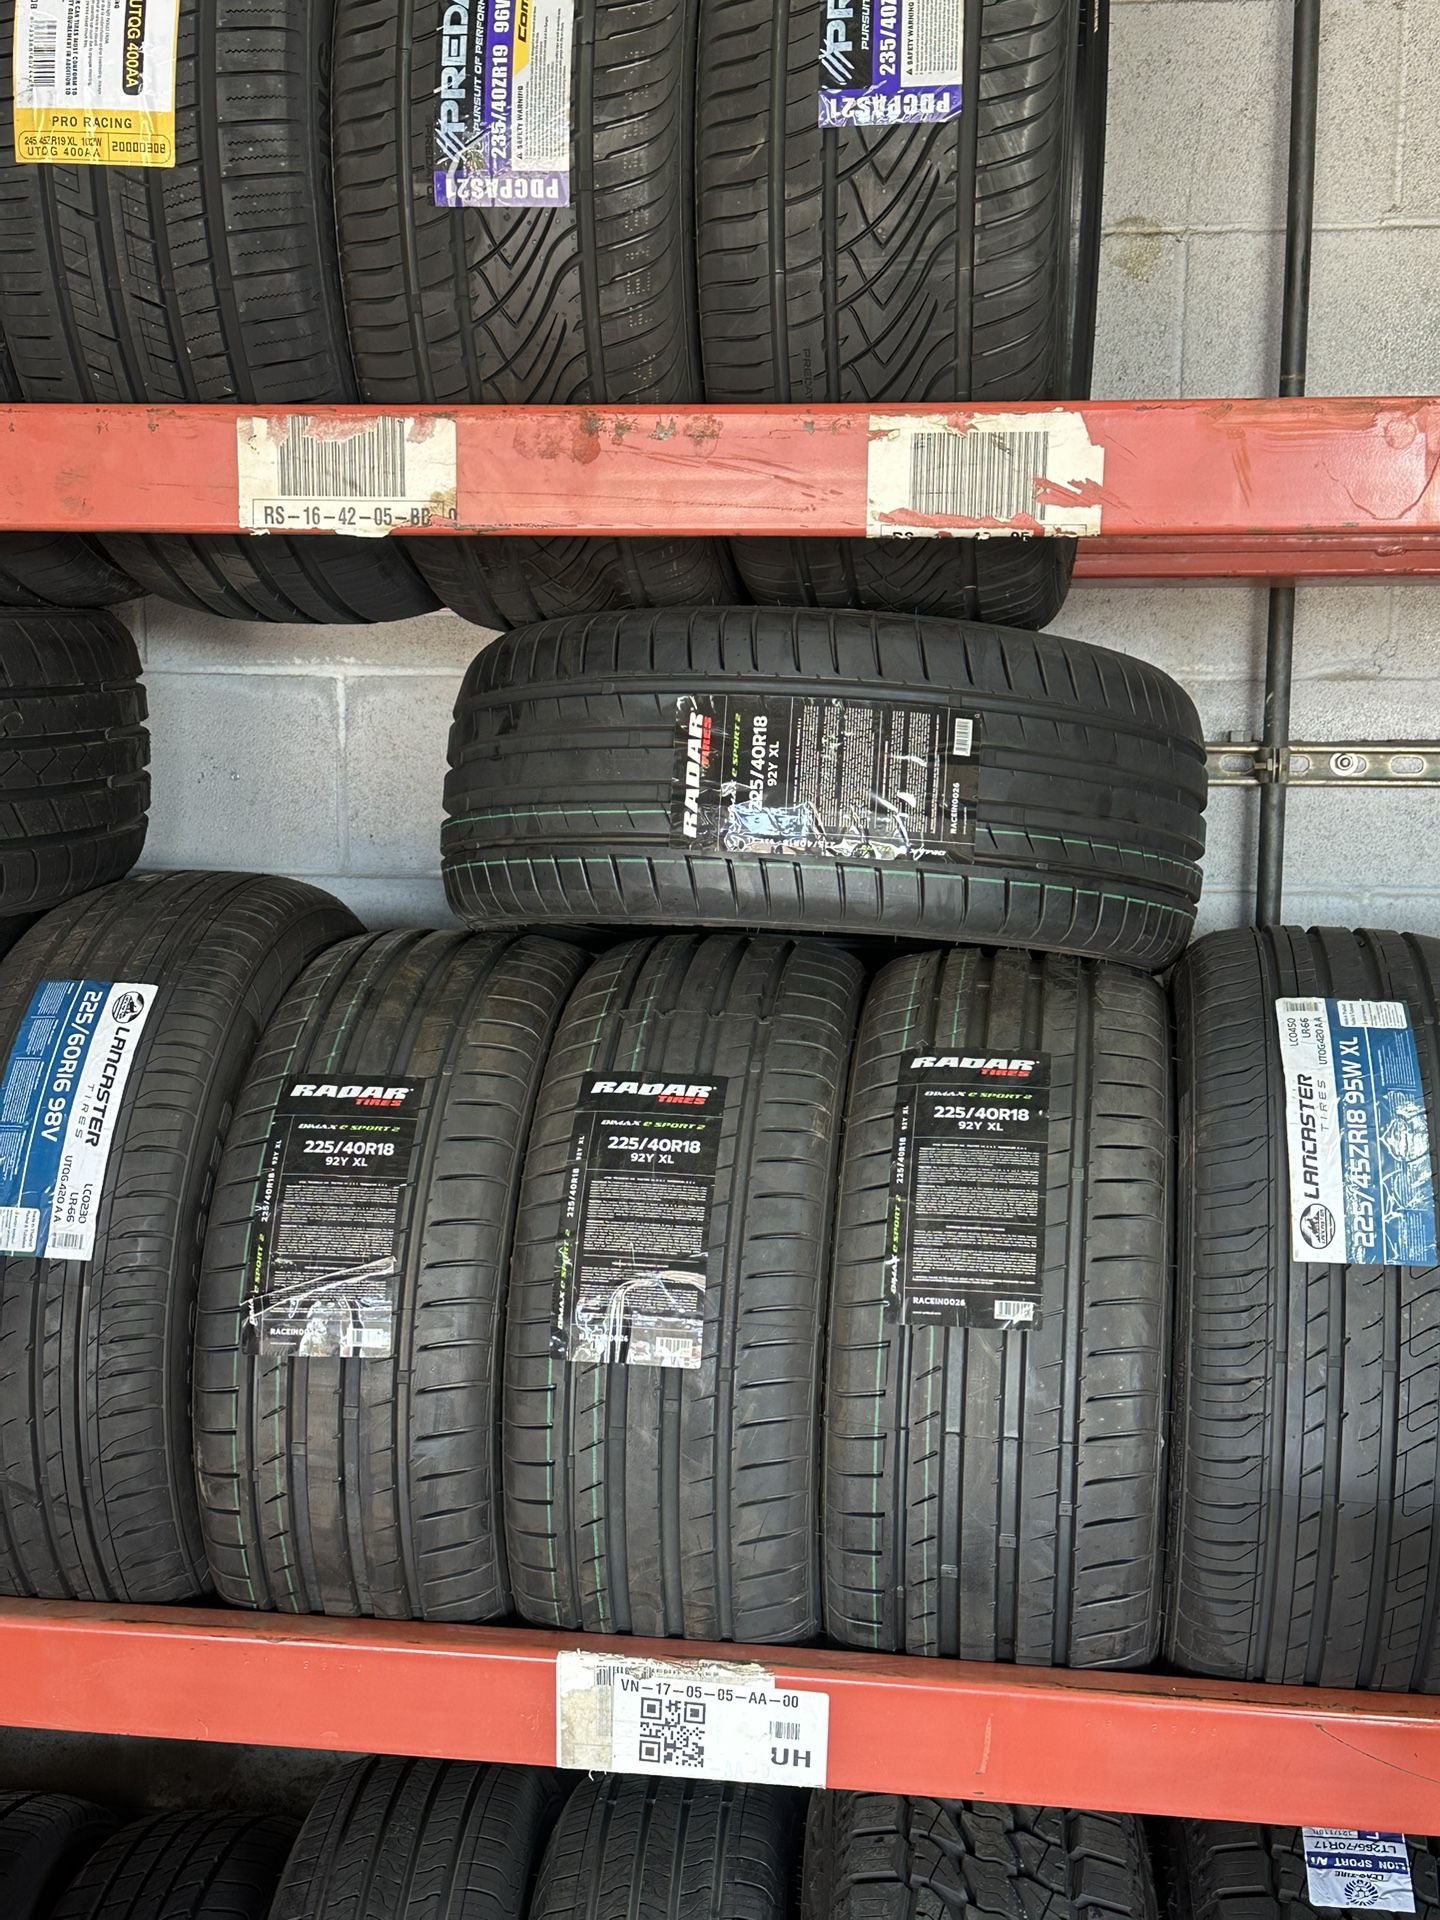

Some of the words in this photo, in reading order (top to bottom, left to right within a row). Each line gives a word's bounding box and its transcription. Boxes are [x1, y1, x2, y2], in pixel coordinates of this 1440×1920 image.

[128, 0, 142, 39] UTQG
[126, 43, 140, 88] 400AA
[474, 56, 483, 74] OF
[473, 77, 484, 135] PURSUIT
[491, 44, 508, 159] 235/40ZR19
[830, 93, 950, 119] PDCPAS21
[52, 116, 78, 128] PRO
[84, 117, 132, 128] RACING
[68, 136, 78, 146] XL
[112, 141, 166, 154] 20000308
[446, 178, 559, 198] PDCPAS21
[735, 712, 742, 722] 2
[732, 723, 740, 766] SPORT
[769, 740, 780, 758] XL
[748, 716, 768, 811] 225/40R18
[683, 712, 704, 838] RADAR
[768, 763, 778, 786] 92Y
[950, 782, 961, 835] RACEIN0026
[52, 990, 103, 1093] 225/60R16
[1286, 1018, 1298, 1046] LC0450
[1339, 1036, 1358, 1056] XL
[910, 1056, 1036, 1070] RADAR
[980, 1068, 1031, 1078] TIRES
[86, 1026, 130, 1147] LANCASTER
[290, 1084, 410, 1100] RADAR
[591, 1081, 711, 1098] RADAR
[1343, 1060, 1365, 1104] 95W
[354, 1097, 402, 1107] TIRES
[657, 1095, 706, 1105] TIRES
[980, 1092, 1021, 1100] SPORT
[1316, 1080, 1328, 1131] TIRES
[41, 1097, 66, 1142] 98V
[75, 1084, 96, 1138] TIRES
[933, 1106, 1030, 1122] 225/40R18
[600, 1119, 641, 1127] DIMAX
[654, 1122, 694, 1130] SPORT
[958, 1121, 983, 1130] 92Y
[987, 1122, 1004, 1132] XL
[608, 1136, 701, 1154] 225/40R18
[1298, 1073, 1320, 1200] LANCASTER
[303, 1140, 394, 1156] 225/40R18
[326, 1157, 348, 1166] 92Y
[352, 1157, 368, 1168] XL
[630, 1153, 655, 1162] 92Y
[658, 1154, 674, 1164] XL
[896, 1137, 907, 1184] 225/40R18
[1347, 1109, 1376, 1248] 225/45ZR18
[78, 1184, 94, 1224] LC0230
[254, 1245, 264, 1286] SPORT
[260, 1172, 276, 1223] 225/40R18
[274, 1139, 282, 1150] XL
[556, 1290, 566, 1330] DIMAX
[567, 1168, 580, 1218] 225/40R18
[577, 1136, 585, 1144] XL
[893, 1204, 901, 1242] SPORT
[912, 1296, 966, 1307] RACEIN0026
[771, 1747, 811, 1768] UH
[1314, 1841, 1396, 1854] LT265/70R17
[1334, 1858, 1372, 1868] SPORT
